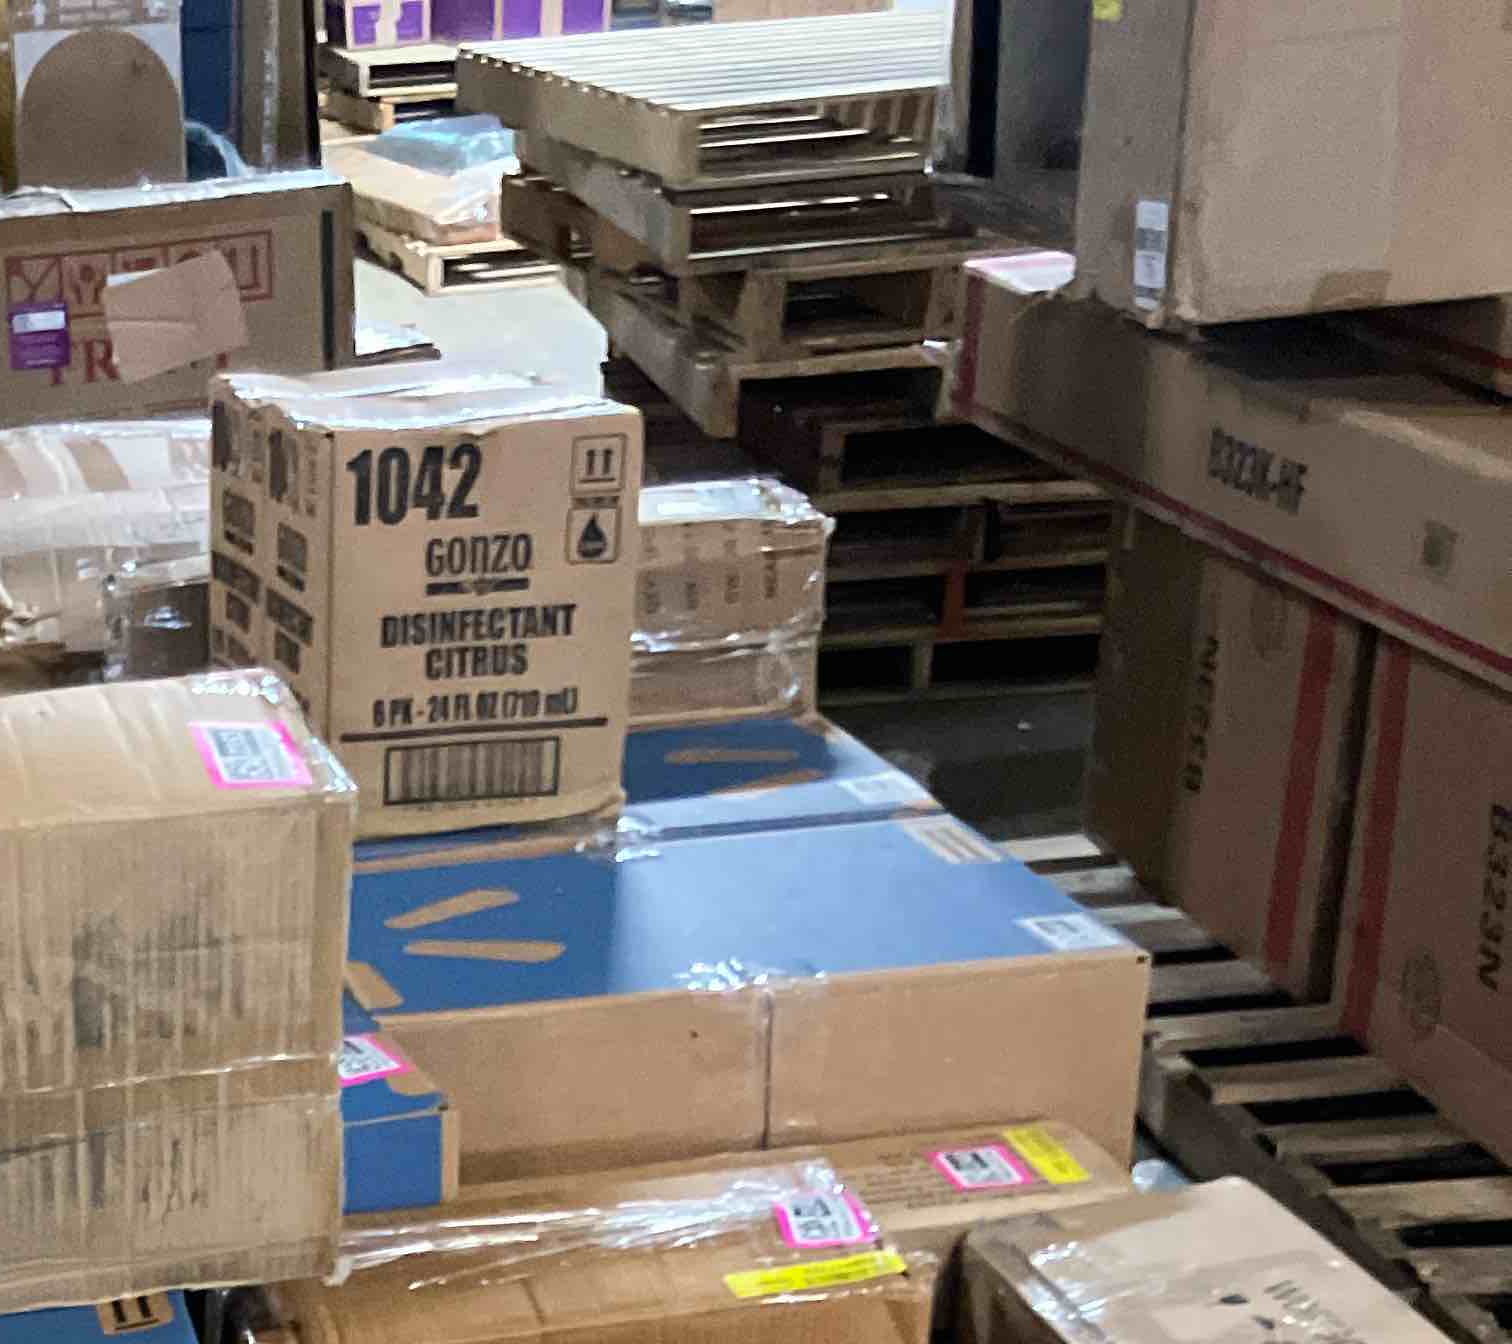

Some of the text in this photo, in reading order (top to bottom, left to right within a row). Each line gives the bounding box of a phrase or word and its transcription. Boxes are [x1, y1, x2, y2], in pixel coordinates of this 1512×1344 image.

[346, 443, 483, 526] 1042
[380, 603, 577, 649] DISINFECTANT
[424, 642, 529, 681] CITRUS
